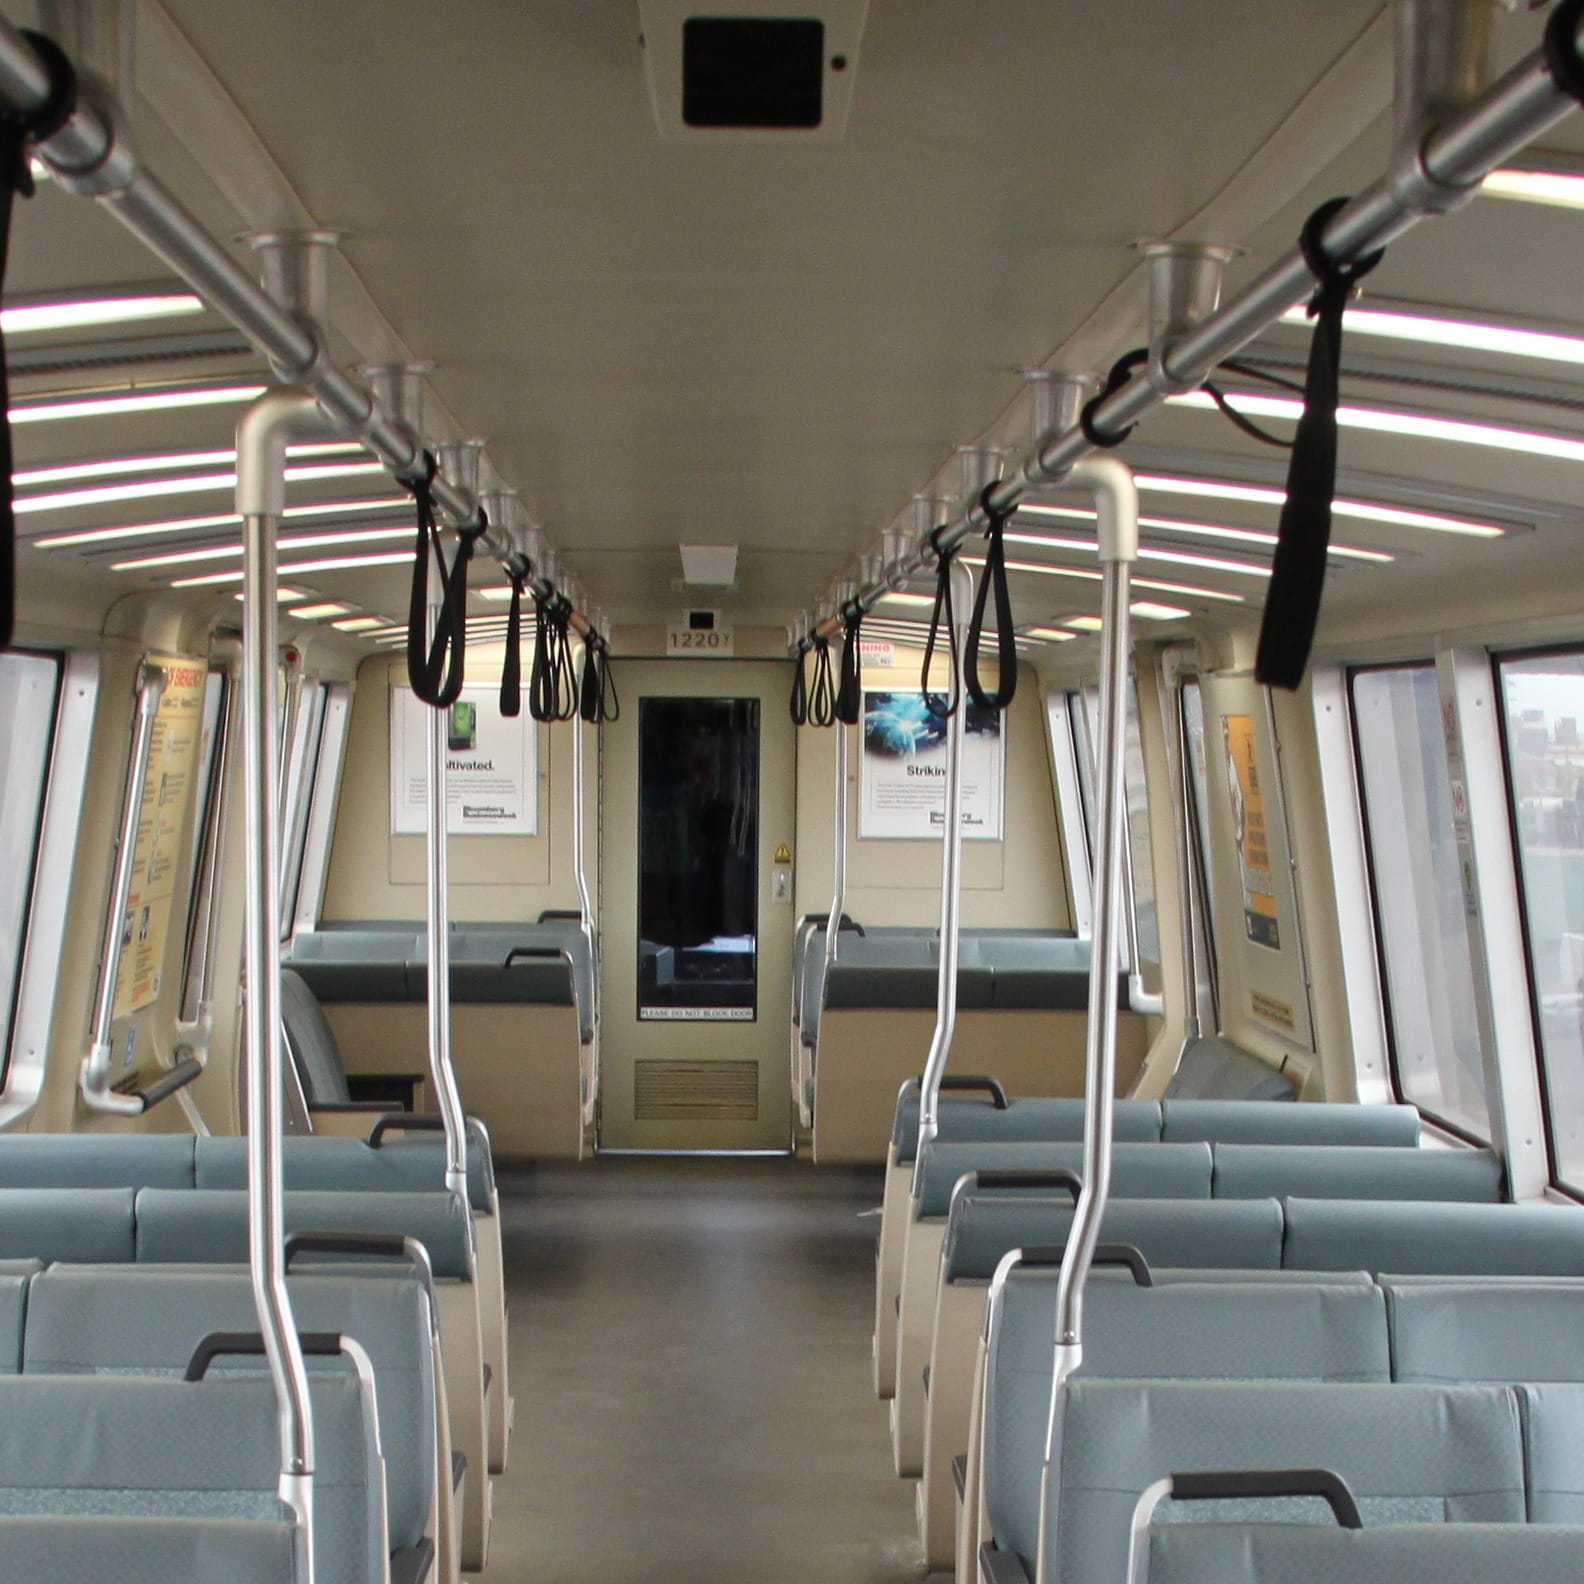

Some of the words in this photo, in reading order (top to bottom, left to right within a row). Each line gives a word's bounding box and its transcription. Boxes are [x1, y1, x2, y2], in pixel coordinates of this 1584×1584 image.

[671, 633, 719, 648] 1220
[446, 760, 494, 771] ltivated.
[907, 764, 945, 776] Strikin
